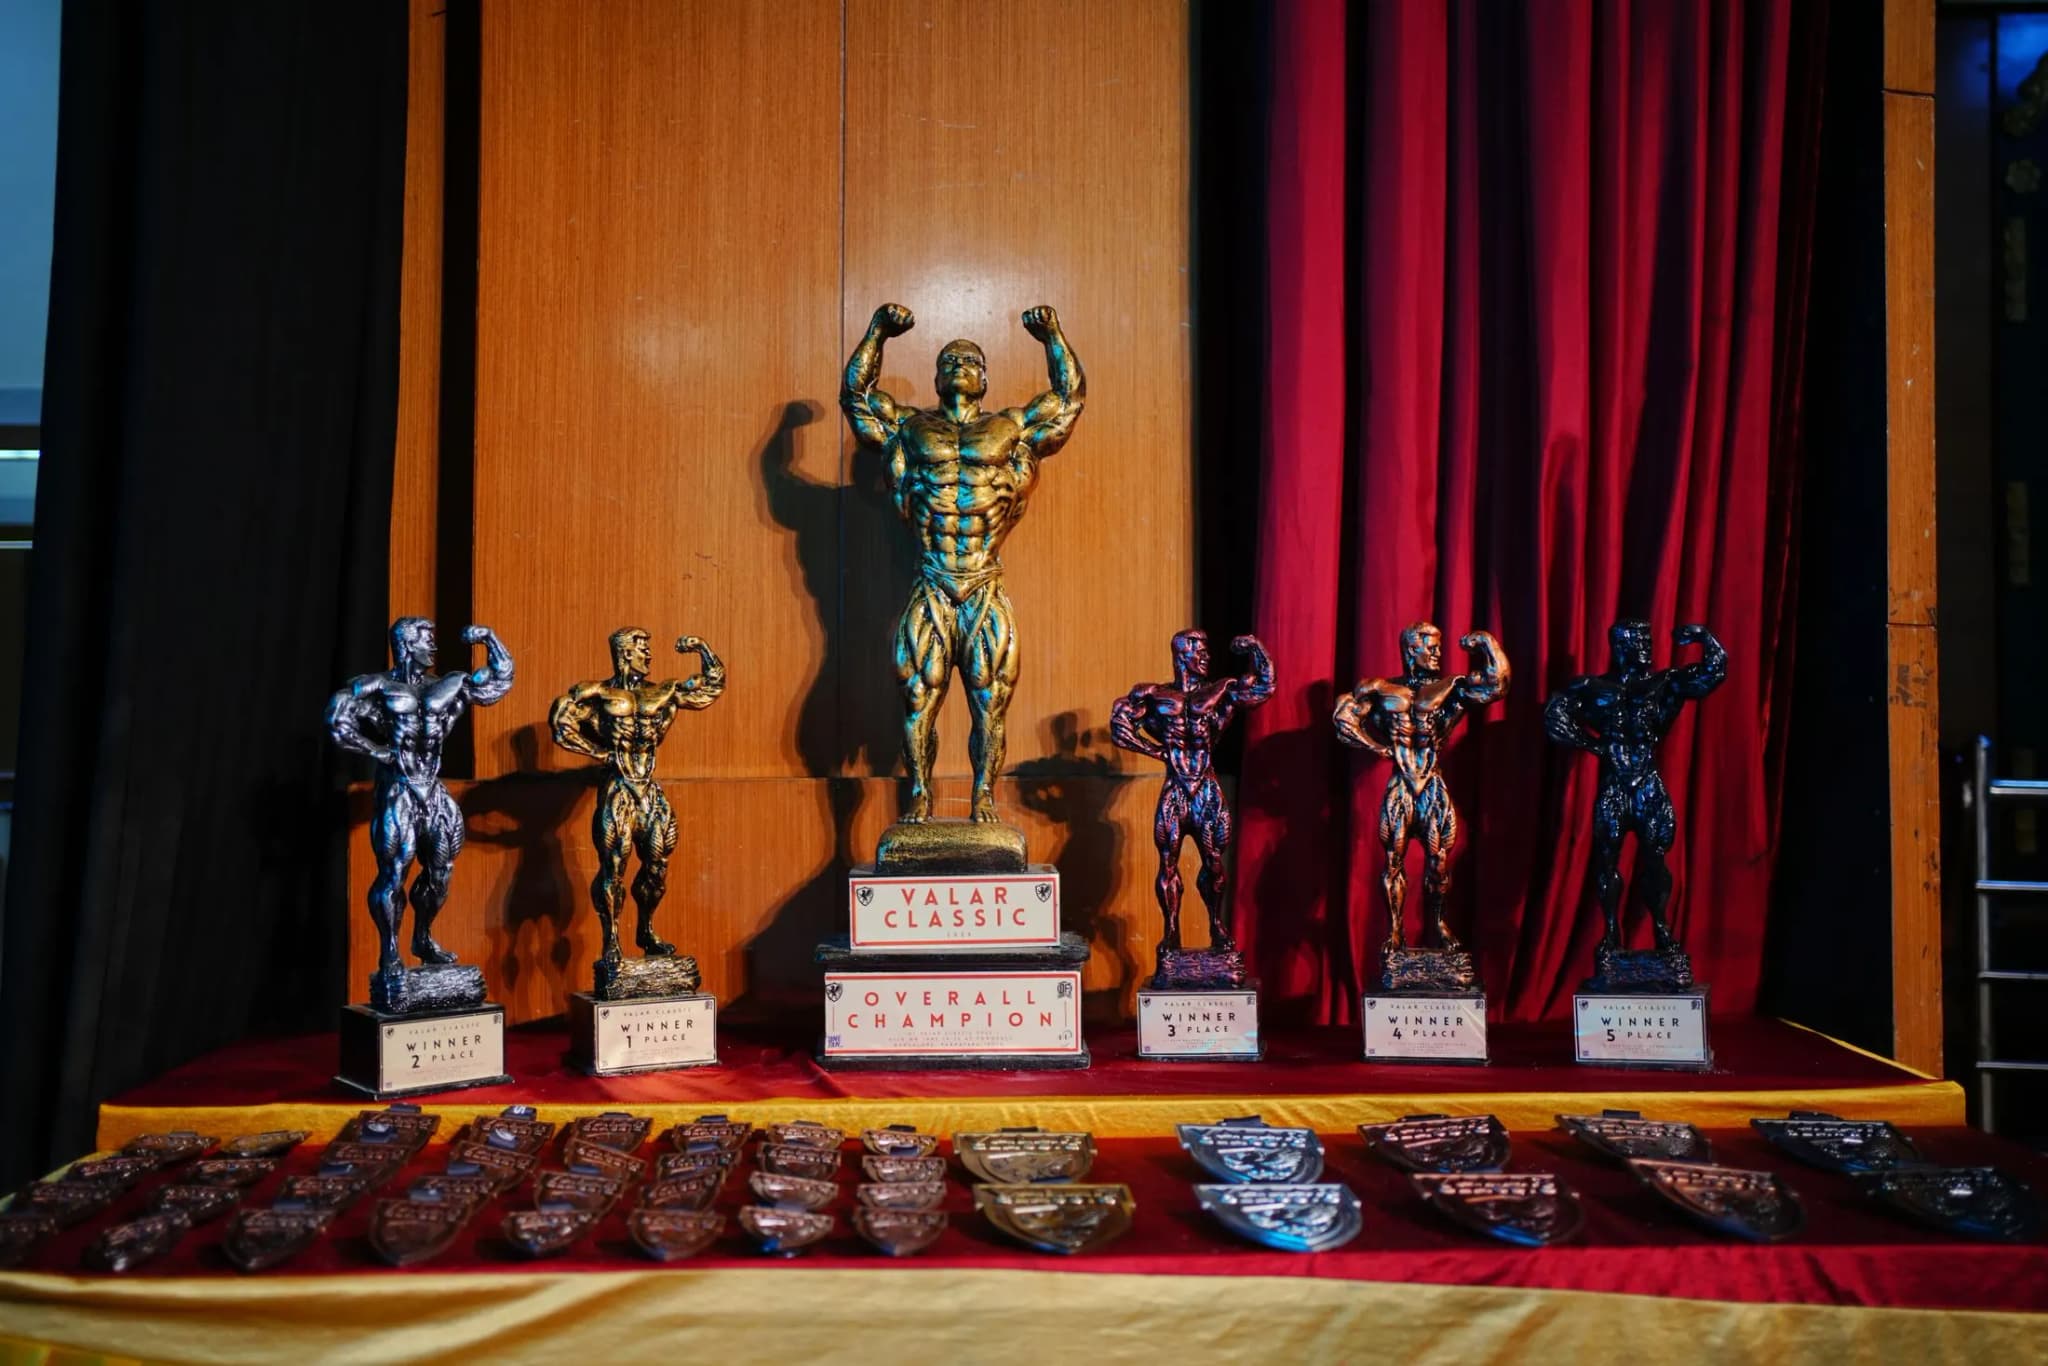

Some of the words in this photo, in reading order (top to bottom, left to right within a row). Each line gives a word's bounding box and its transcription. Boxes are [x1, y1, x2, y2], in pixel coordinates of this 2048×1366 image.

[901, 886, 1008, 905] VALAR
[883, 908, 1026, 928] CLASSIC
[864, 990, 1036, 1006] OVERALL
[847, 1011, 1052, 1029] CHAMPION
[1162, 1012, 1236, 1022] WINNER
[1388, 1015, 1464, 1027] WINNER
[1601, 1017, 1680, 1027] WINNER
[620, 1019, 694, 1033] WINNER
[1167, 1024, 1176, 1037] 3
[1187, 1025, 1230, 1033] PLACE
[626, 1035, 632, 1048] 1
[644, 1033, 686, 1044] PLACE
[1392, 1027, 1402, 1040] 4
[1412, 1029, 1457, 1038] PLACE
[1607, 1029, 1616, 1042] 5
[1627, 1031, 1673, 1039] PLACE
[406, 1034, 481, 1052] WINNER
[411, 1055, 421, 1069] 2
[431, 1050, 474, 1062] PLACE
